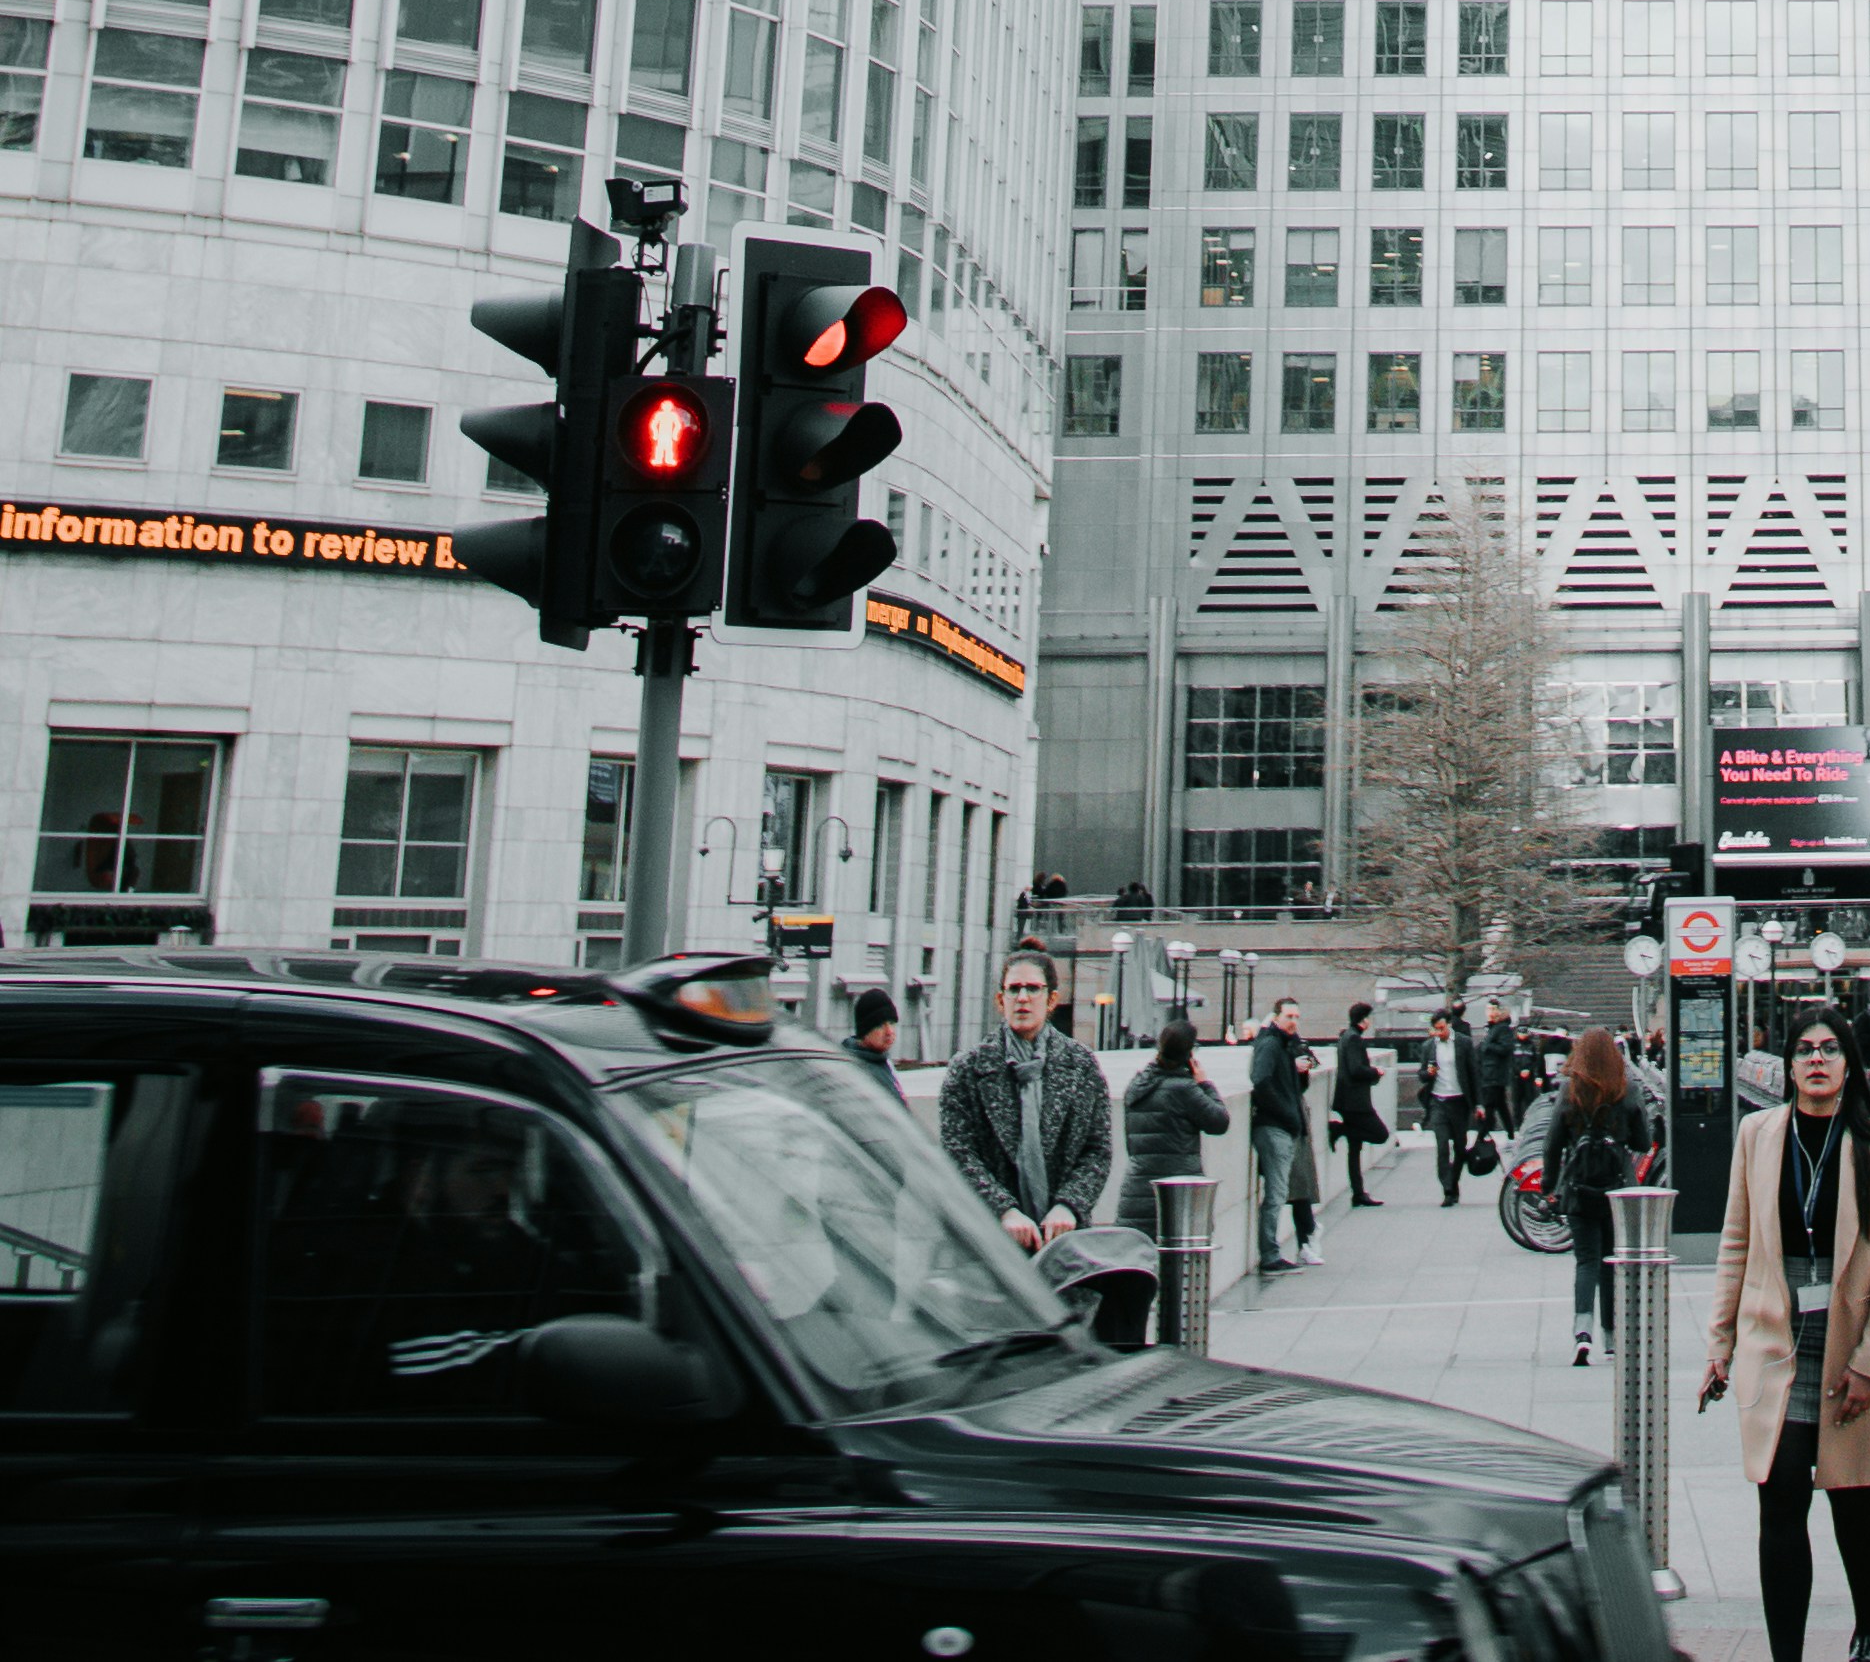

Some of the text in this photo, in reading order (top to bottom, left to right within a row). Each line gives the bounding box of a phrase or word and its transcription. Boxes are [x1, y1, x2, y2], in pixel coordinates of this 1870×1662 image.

[0, 503, 244, 553] information
[253, 521, 295, 556] to
[303, 529, 429, 567] review
[1719, 749, 1864, 767] A Bike & Everything
[1720, 766, 1849, 782] You Need To Ride
